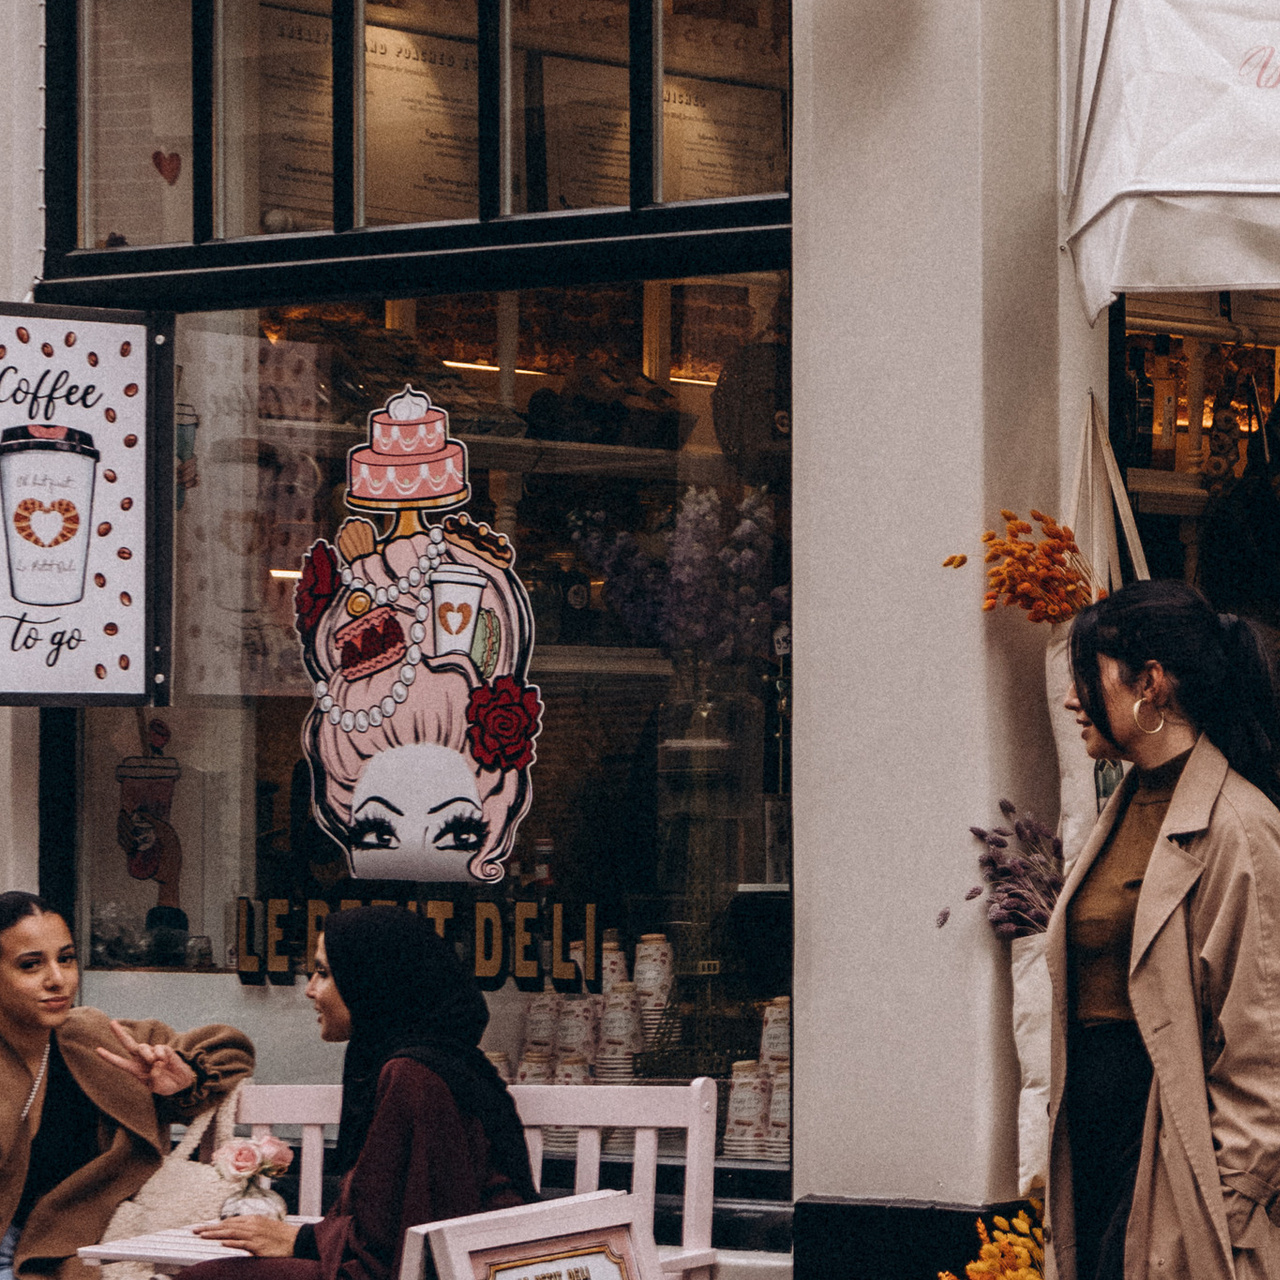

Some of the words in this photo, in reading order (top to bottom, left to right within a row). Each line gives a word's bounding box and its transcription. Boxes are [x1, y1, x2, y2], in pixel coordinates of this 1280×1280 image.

[0, 365, 104, 421] Coffee
[2, 612, 58, 652] to
[46, 628, 87, 667] go
[237, 897, 292, 978] LE
[475, 901, 599, 986] DELI
